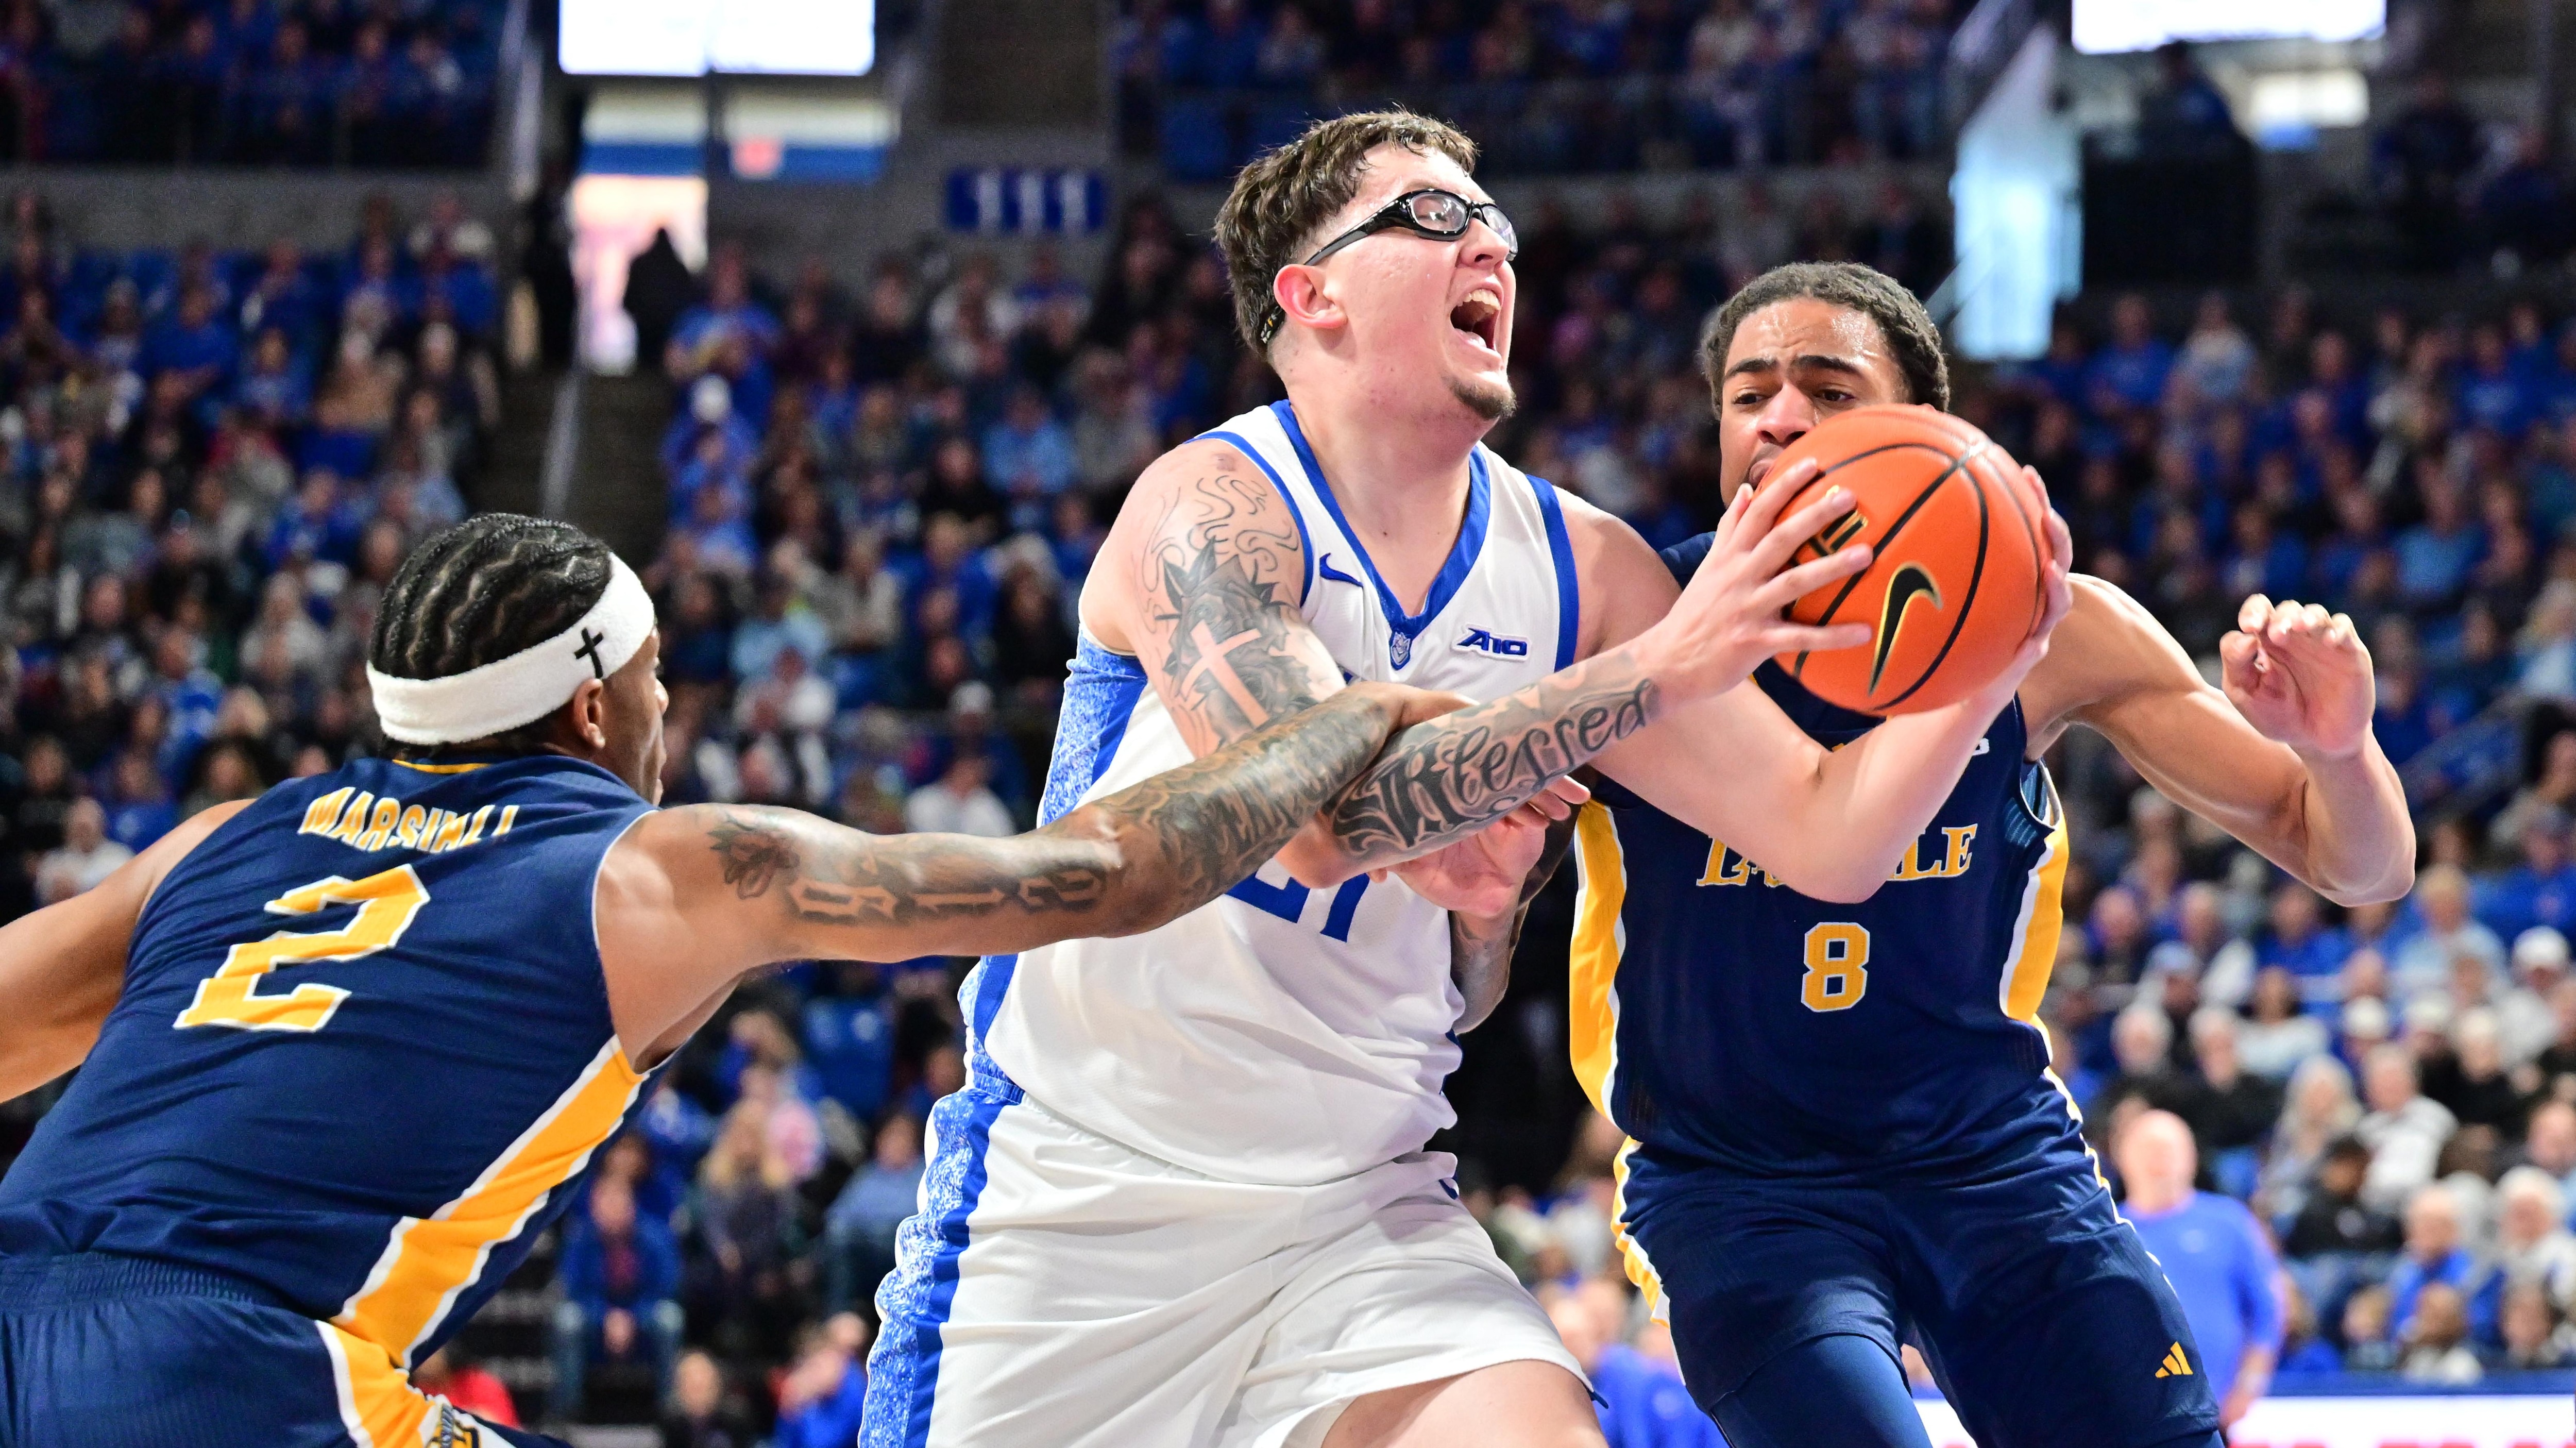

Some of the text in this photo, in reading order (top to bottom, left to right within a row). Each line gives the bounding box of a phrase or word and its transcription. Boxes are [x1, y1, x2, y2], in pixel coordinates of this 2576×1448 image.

[975, 169, 1087, 235] 111
[1456, 627, 1528, 656] A10
[173, 863, 431, 1033] 2
[1800, 921, 1871, 1013] 8
